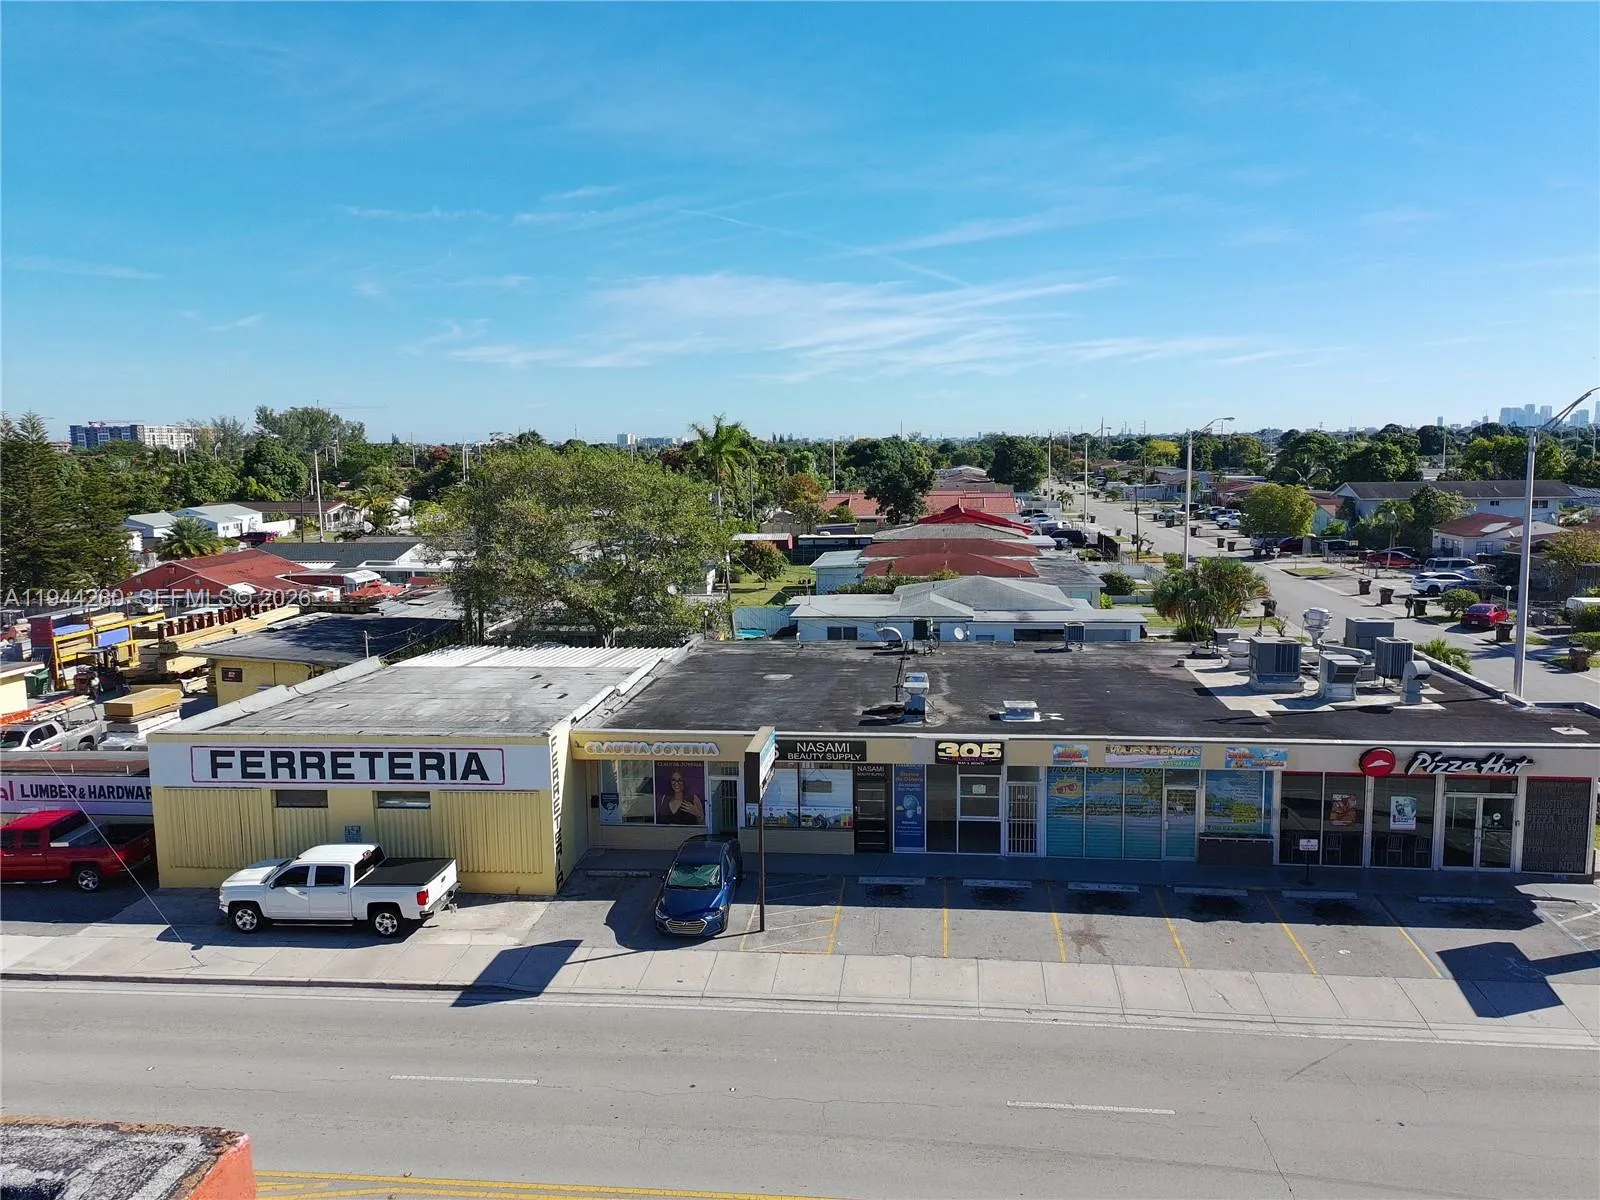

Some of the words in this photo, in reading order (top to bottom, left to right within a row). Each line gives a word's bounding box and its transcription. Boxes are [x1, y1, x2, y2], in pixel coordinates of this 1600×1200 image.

[585, 741, 650, 755] CLAUDIA
[652, 742, 719, 756] JOYERIA
[796, 742, 850, 753] NASAMI
[938, 742, 1002, 758] 305
[826, 753, 861, 761] SUPPLY
[1408, 752, 1478, 775] Pizza
[1480, 755, 1533, 775] Hut
[209, 749, 490, 781] FERRETERIA
[857, 765, 885, 773] NASAMI
[20, 783, 77, 799] LUMBER
